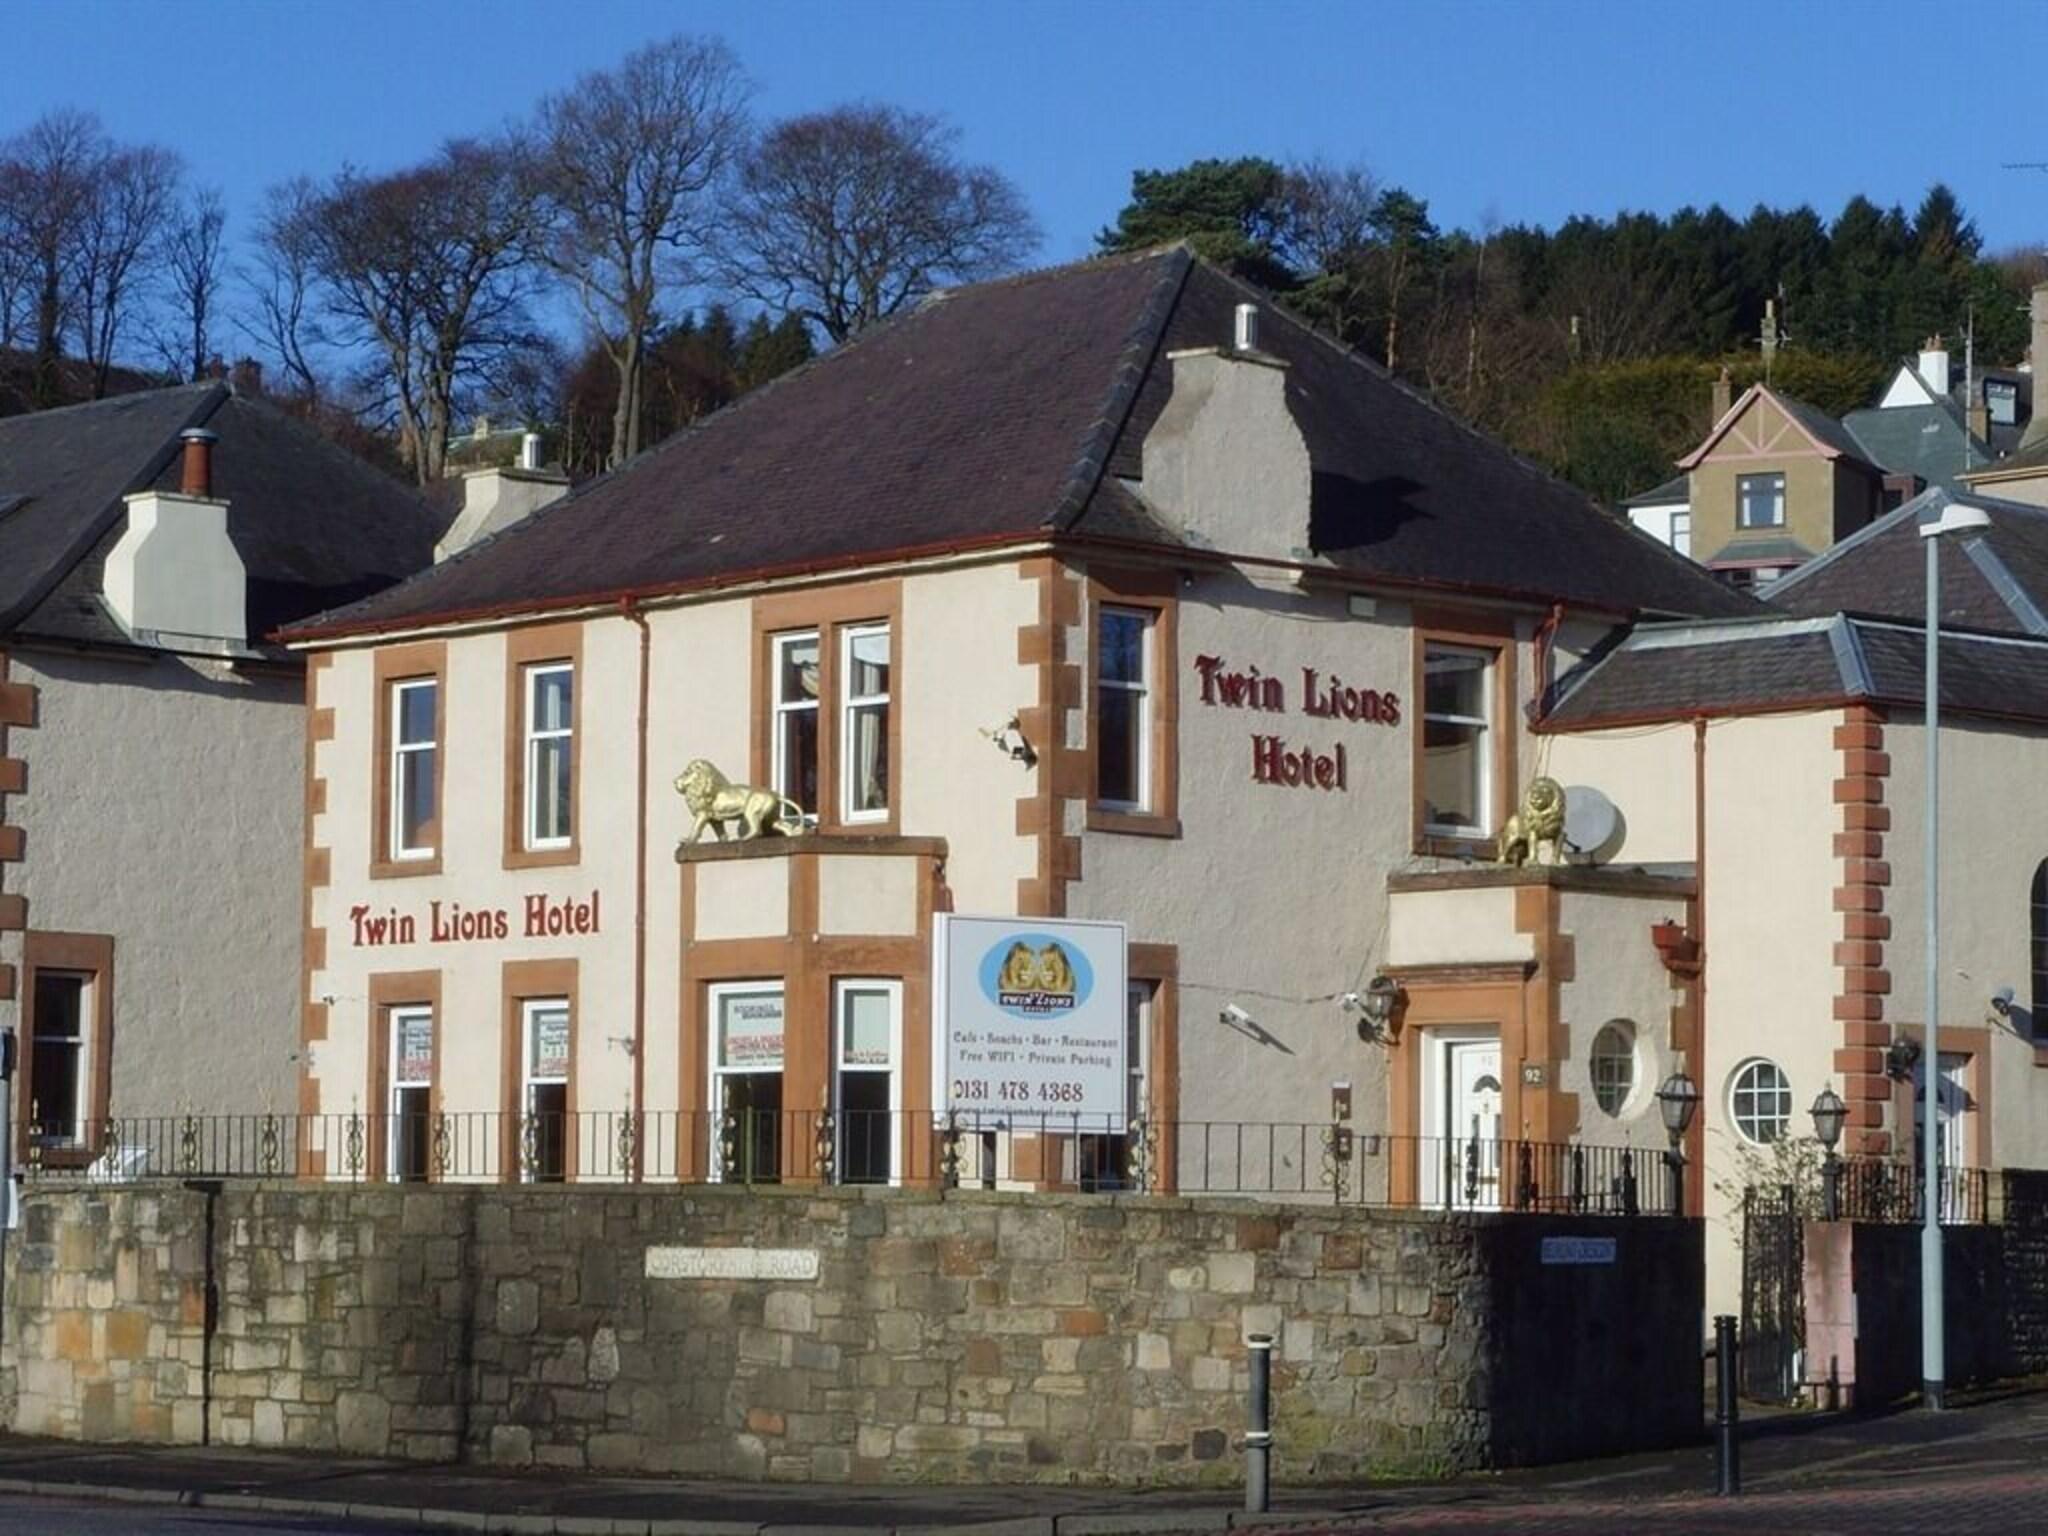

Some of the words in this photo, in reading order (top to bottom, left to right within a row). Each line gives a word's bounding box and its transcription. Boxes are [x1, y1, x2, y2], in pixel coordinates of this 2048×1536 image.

[1194, 654, 1285, 713] Twin
[1302, 666, 1401, 727] Lions
[1251, 733, 1347, 791] Hotel
[350, 904, 416, 947] Twin
[430, 900, 509, 942] Lions
[524, 889, 600, 937] Hotel
[959, 1050, 983, 1061] Free
[1028, 1052, 1065, 1065] Private
[1070, 1053, 1112, 1068] Parking
[1032, 1034, 1052, 1046] Bar
[1061, 1035, 1118, 1048] Restaurant
[954, 1079, 989, 1100] 0131
[998, 1081, 1029, 1101] 478
[1038, 1082, 1083, 1102] 4368
